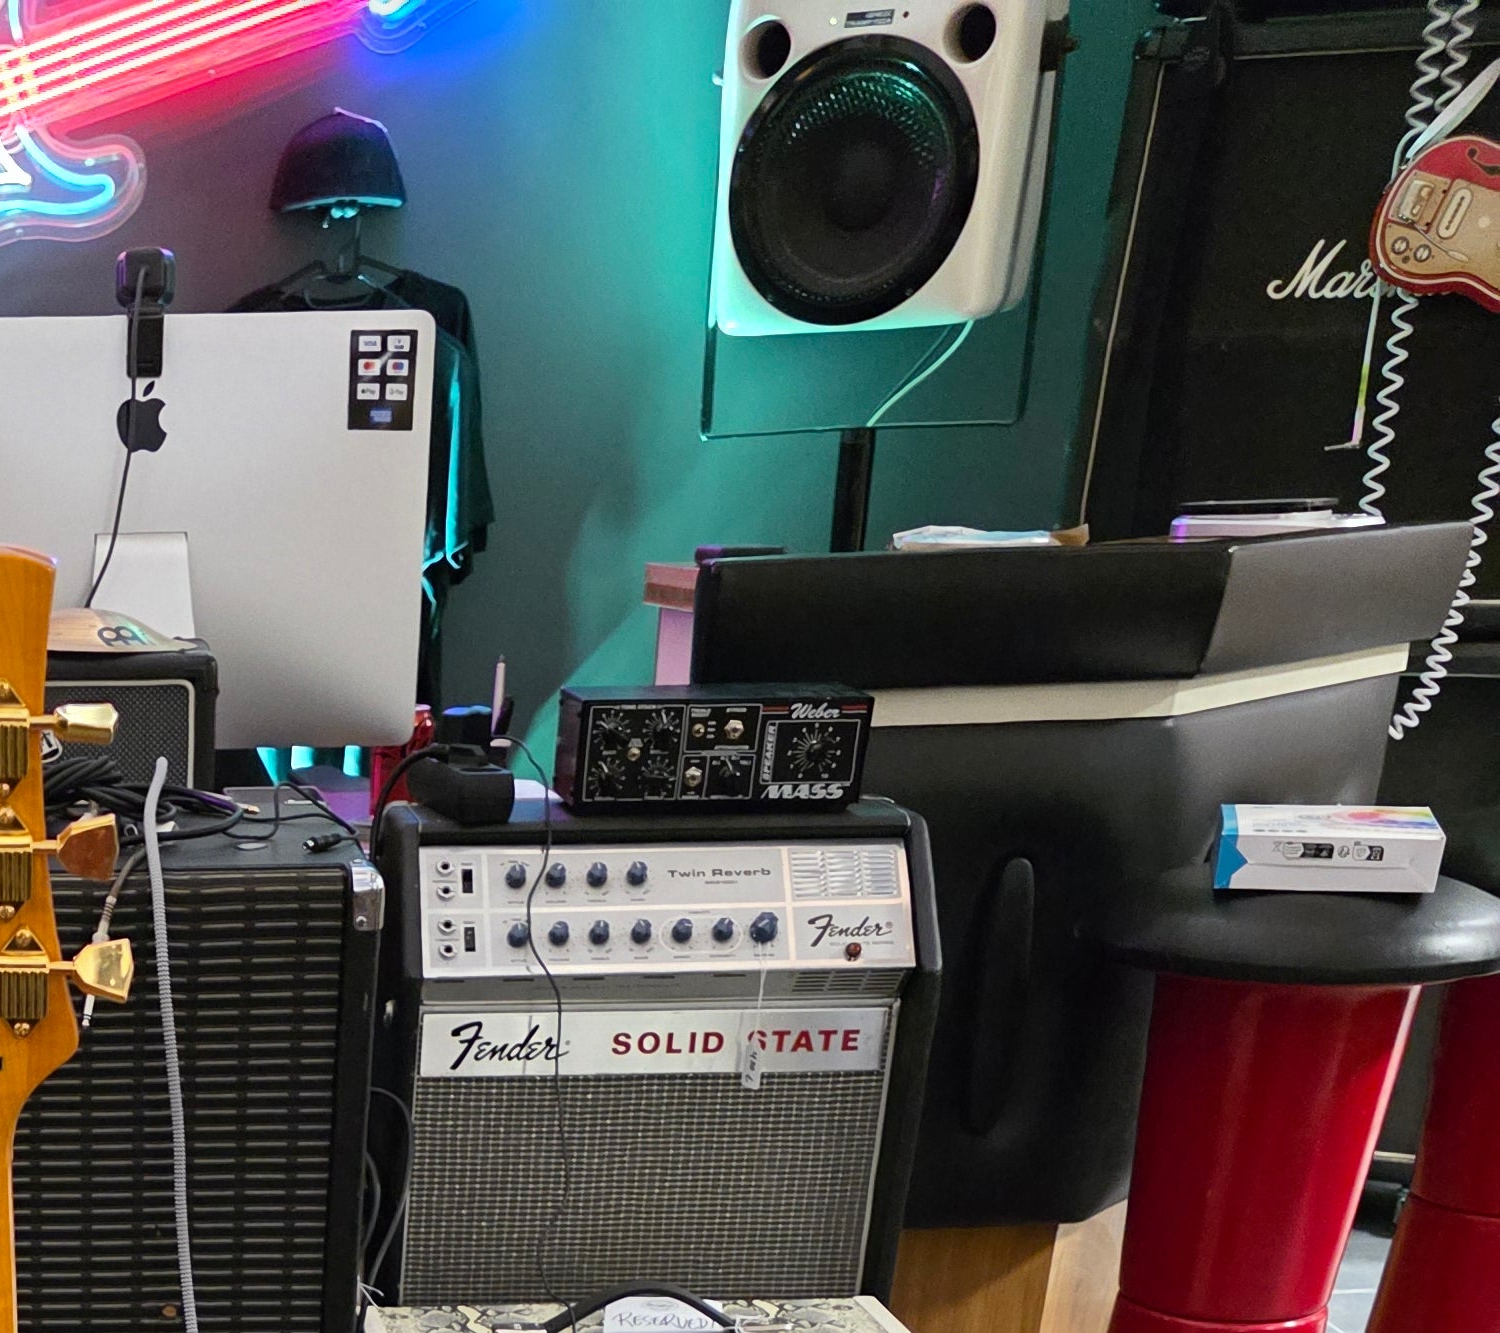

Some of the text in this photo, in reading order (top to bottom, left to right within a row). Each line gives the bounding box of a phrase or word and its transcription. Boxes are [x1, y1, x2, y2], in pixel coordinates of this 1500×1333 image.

[791, 703, 841, 719] Weber
[762, 725, 777, 781] SPEAKER
[761, 784, 844, 799] MASS
[668, 867, 772, 879] Twin Reverb
[807, 913, 893, 948] Fender
[450, 1021, 571, 1071] Fender
[611, 1029, 861, 1055] SOLID STATE
